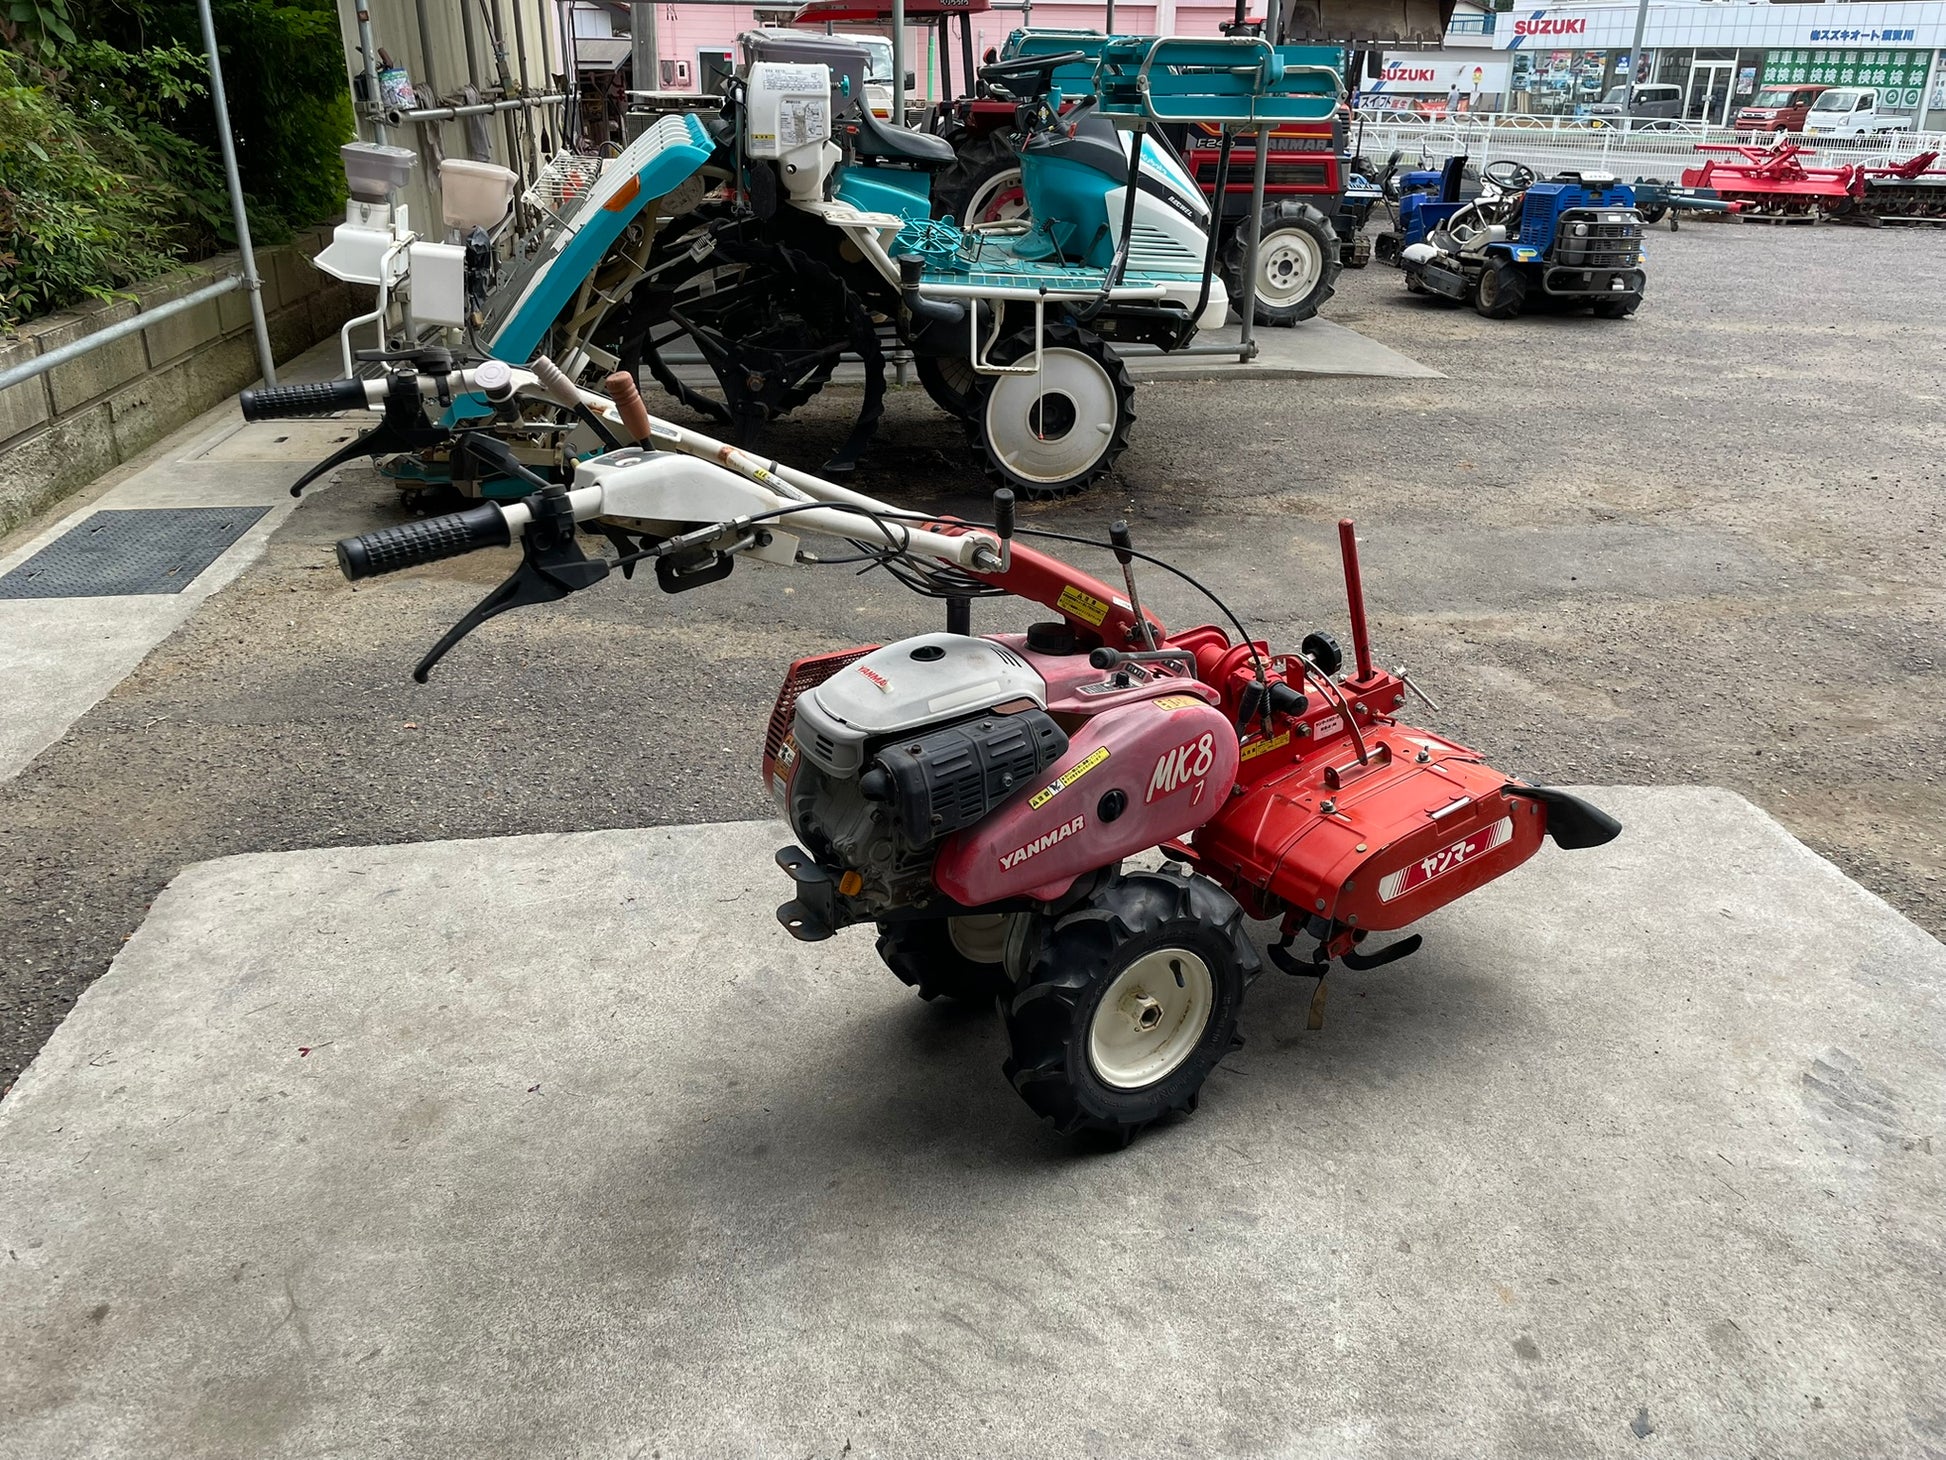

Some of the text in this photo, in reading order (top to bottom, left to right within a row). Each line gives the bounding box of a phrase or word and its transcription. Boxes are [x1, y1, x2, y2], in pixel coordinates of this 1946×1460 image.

[1514, 19, 1586, 35] SUZUKI
[1379, 69, 1435, 81] SUZUKI
[1257, 138, 1327, 150] ANMAR
[1146, 733, 1213, 803] MK8
[999, 815, 1085, 870] YANMAR
[1421, 841, 1476, 879] ヤンマー
